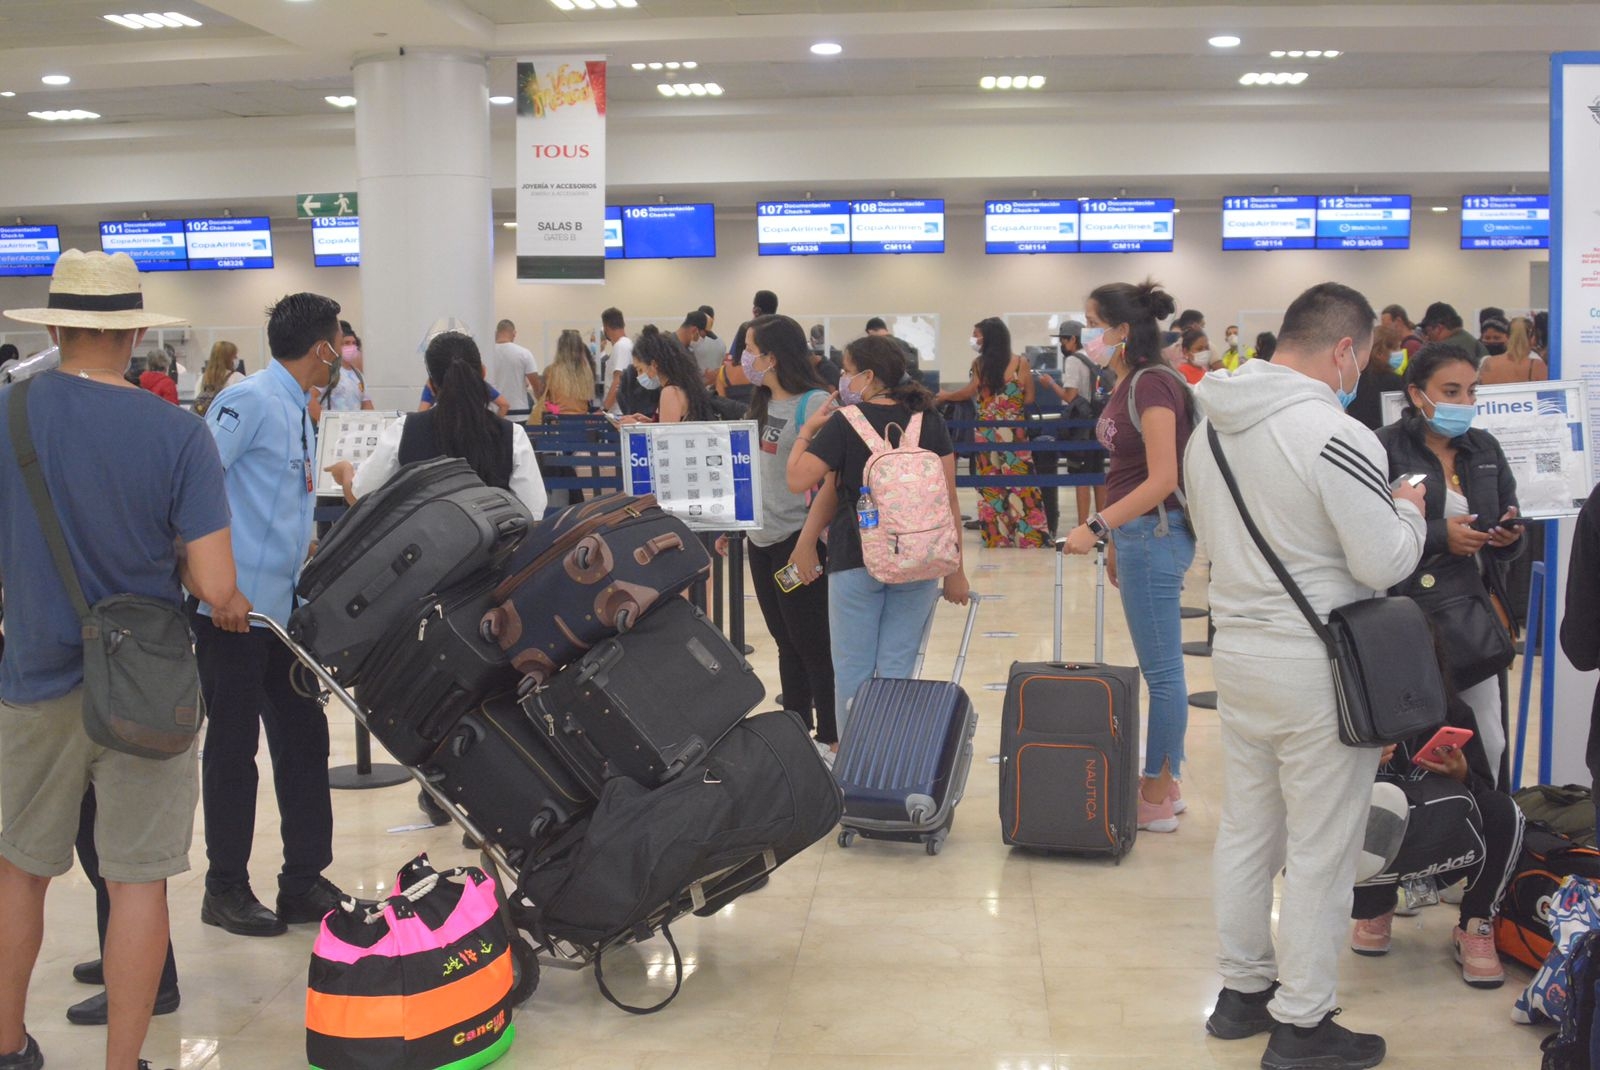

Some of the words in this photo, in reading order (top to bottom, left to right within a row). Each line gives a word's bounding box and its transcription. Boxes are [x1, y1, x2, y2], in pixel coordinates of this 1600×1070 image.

[532, 144, 590, 158] TOUS
[853, 203, 877, 213] 108
[988, 203, 1012, 213] 109
[1083, 202, 1107, 212] 110
[1225, 198, 1249, 209] 111
[1320, 198, 1344, 208] 112
[1464, 198, 1489, 208] 113
[624, 208, 648, 218] 106
[760, 204, 783, 215] 107
[187, 222, 209, 232] 102
[313, 217, 337, 227] 103
[537, 221, 572, 231] SALAS
[575, 222, 583, 231] B
[856, 223, 922, 231] CopaAirlines
[1085, 222, 1151, 231] CopaAirlines
[1227, 219, 1294, 227] CopaAirlines
[102, 224, 123, 234] 101
[763, 225, 829, 233] CopaAirlines
[991, 223, 1057, 232] CopaAirlines
[543, 233, 569, 241] GATES
[570, 233, 577, 241] B
[191, 241, 252, 249] CopaAirlines
[1018, 243, 1046, 251] CM114
[1112, 242, 1140, 250] CM114
[1254, 239, 1283, 247] CM114
[1342, 239, 1356, 247] NO
[1358, 239, 1383, 247] BAGS
[1085, 759, 1097, 820] NAUTICA
[1400, 849, 1476, 881] adidas
